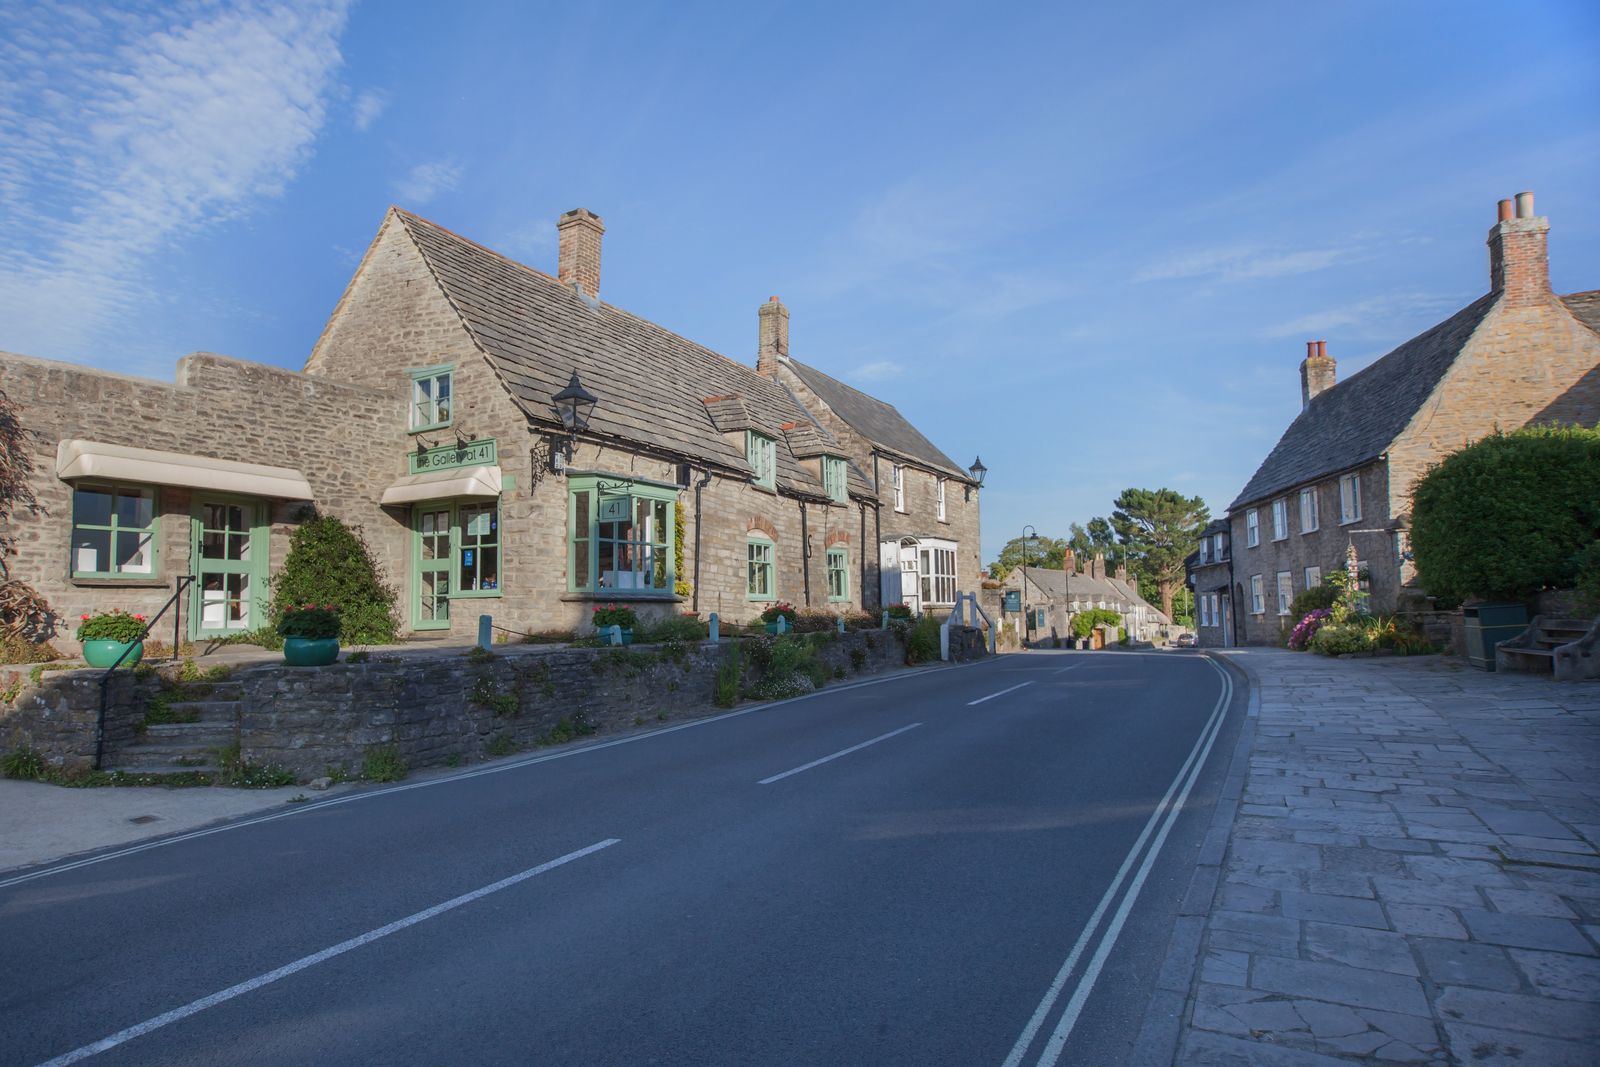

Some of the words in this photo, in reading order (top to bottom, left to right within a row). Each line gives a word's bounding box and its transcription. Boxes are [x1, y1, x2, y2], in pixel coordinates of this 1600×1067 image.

[467, 449, 476, 461] at
[479, 446, 489, 459] 41
[608, 502, 620, 516] 41
